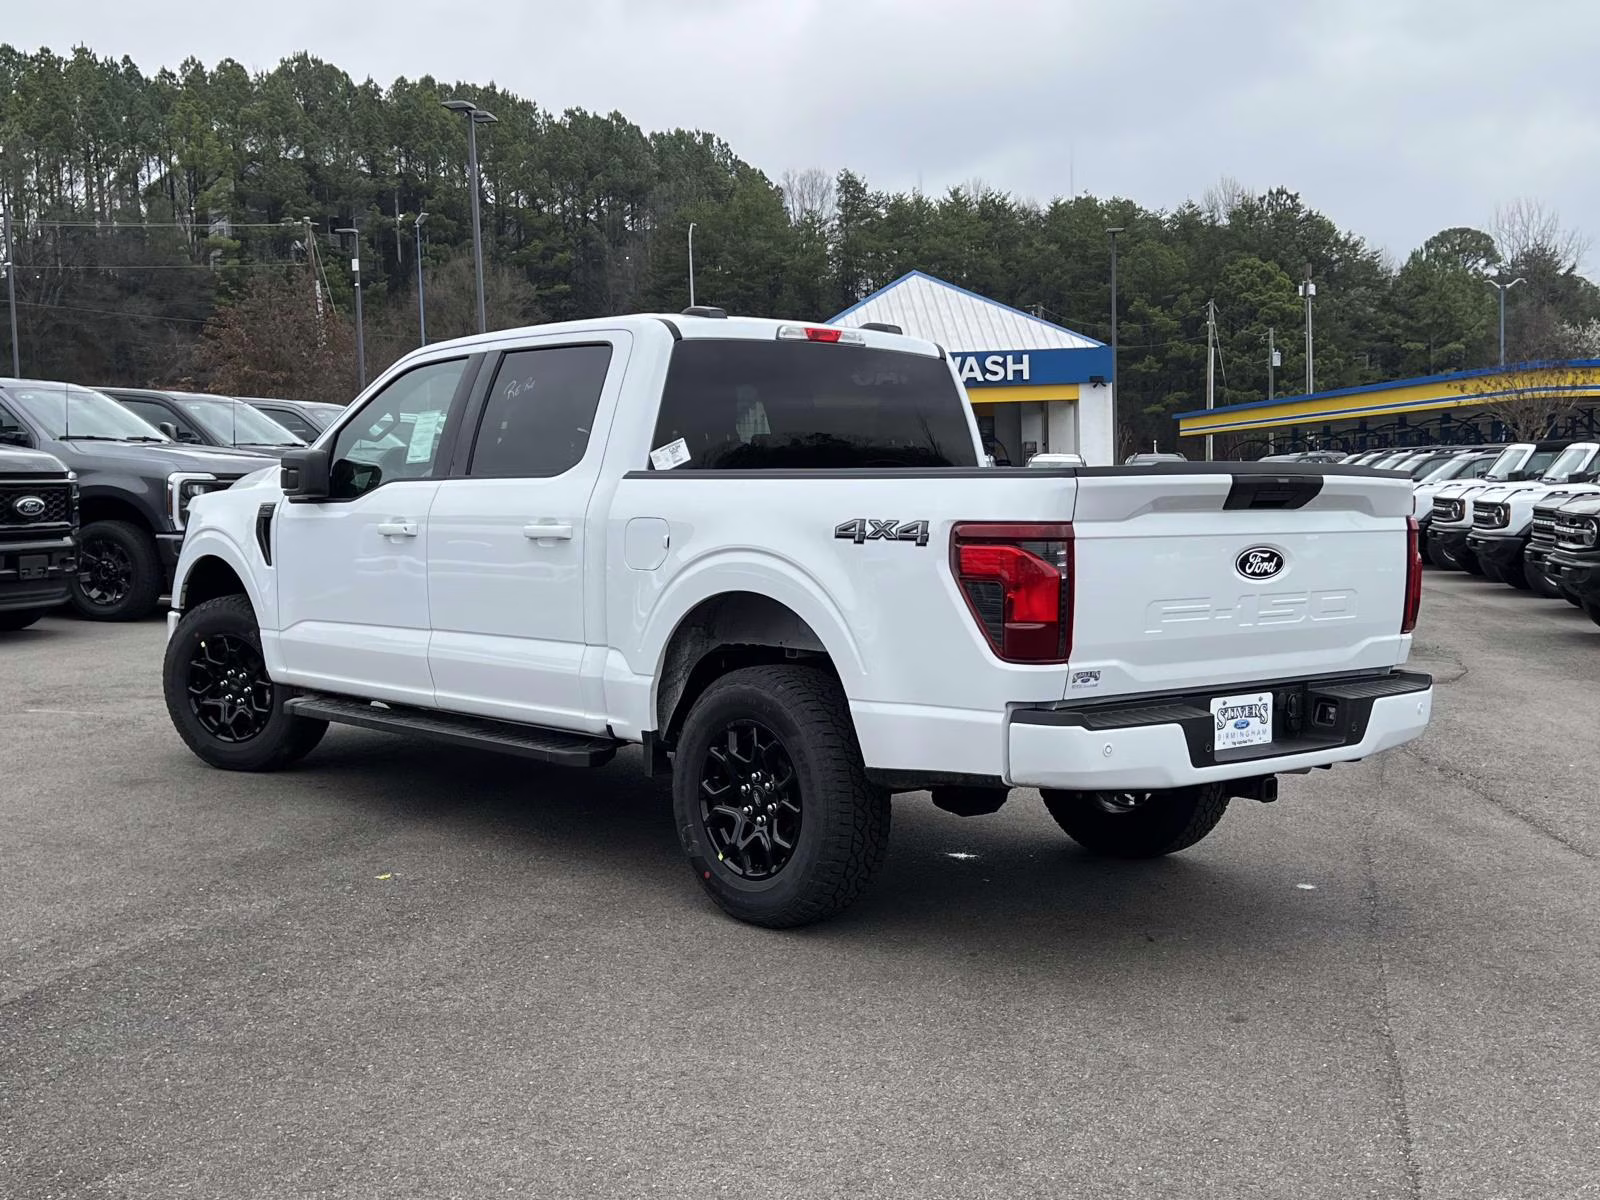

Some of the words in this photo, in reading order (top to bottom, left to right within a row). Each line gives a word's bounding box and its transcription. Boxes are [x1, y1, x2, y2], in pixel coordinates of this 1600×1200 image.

[1245, 551, 1277, 574] Ford
[1144, 588, 1358, 634] F-150
[1216, 703, 1268, 730] STIVERS
